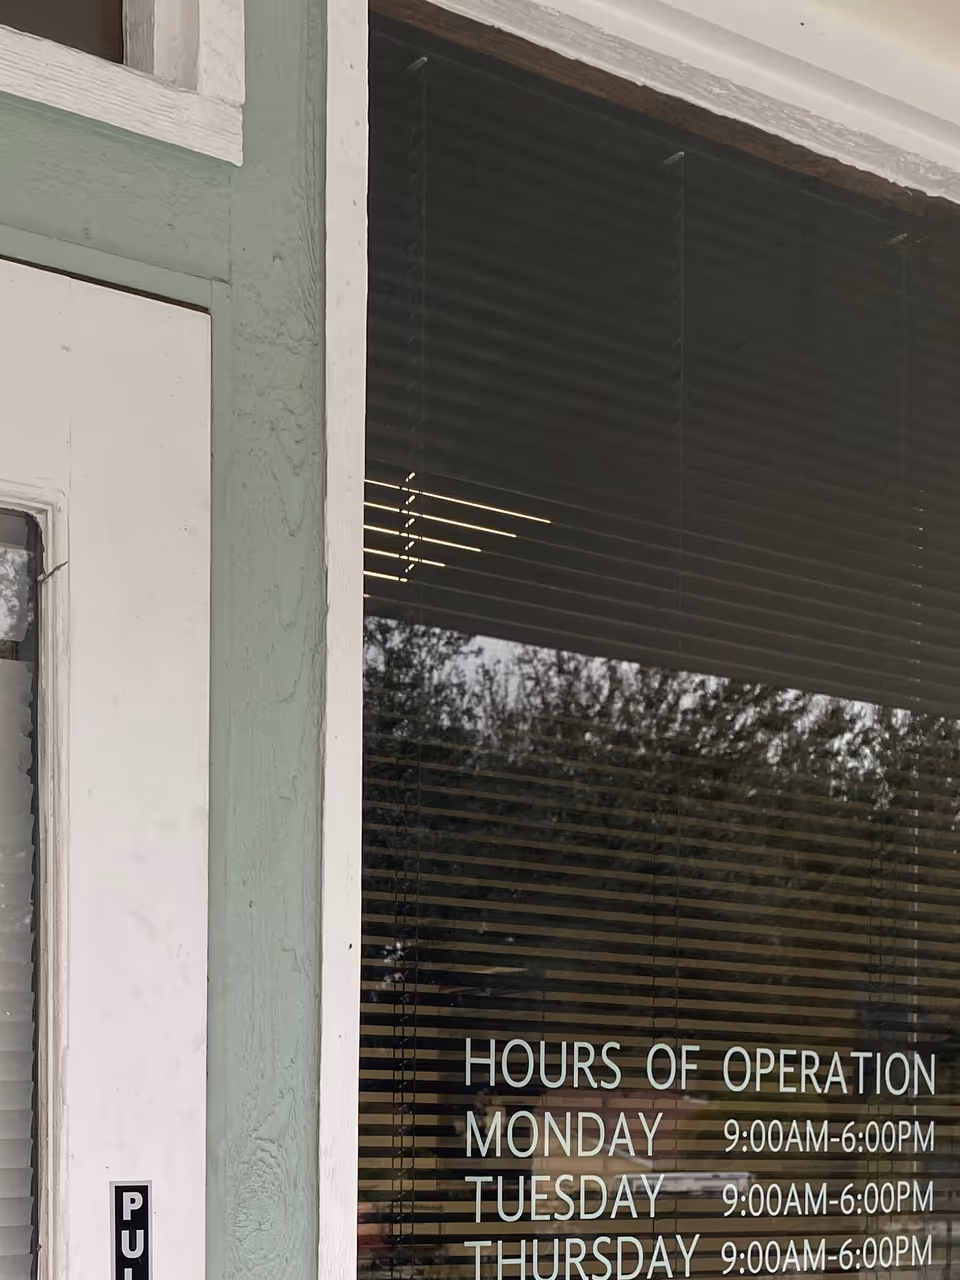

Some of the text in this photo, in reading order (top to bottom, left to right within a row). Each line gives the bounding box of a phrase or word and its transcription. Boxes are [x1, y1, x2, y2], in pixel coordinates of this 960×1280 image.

[465, 1037, 936, 1096] HOURS OF OPERATION
[465, 1111, 935, 1157] MONDAY 9:00AM-6:00PM
[464, 1174, 934, 1223] TUESDAY 9:00AM-6:00PM
[720, 1235, 933, 1275] 9:00AM-6:00PM
